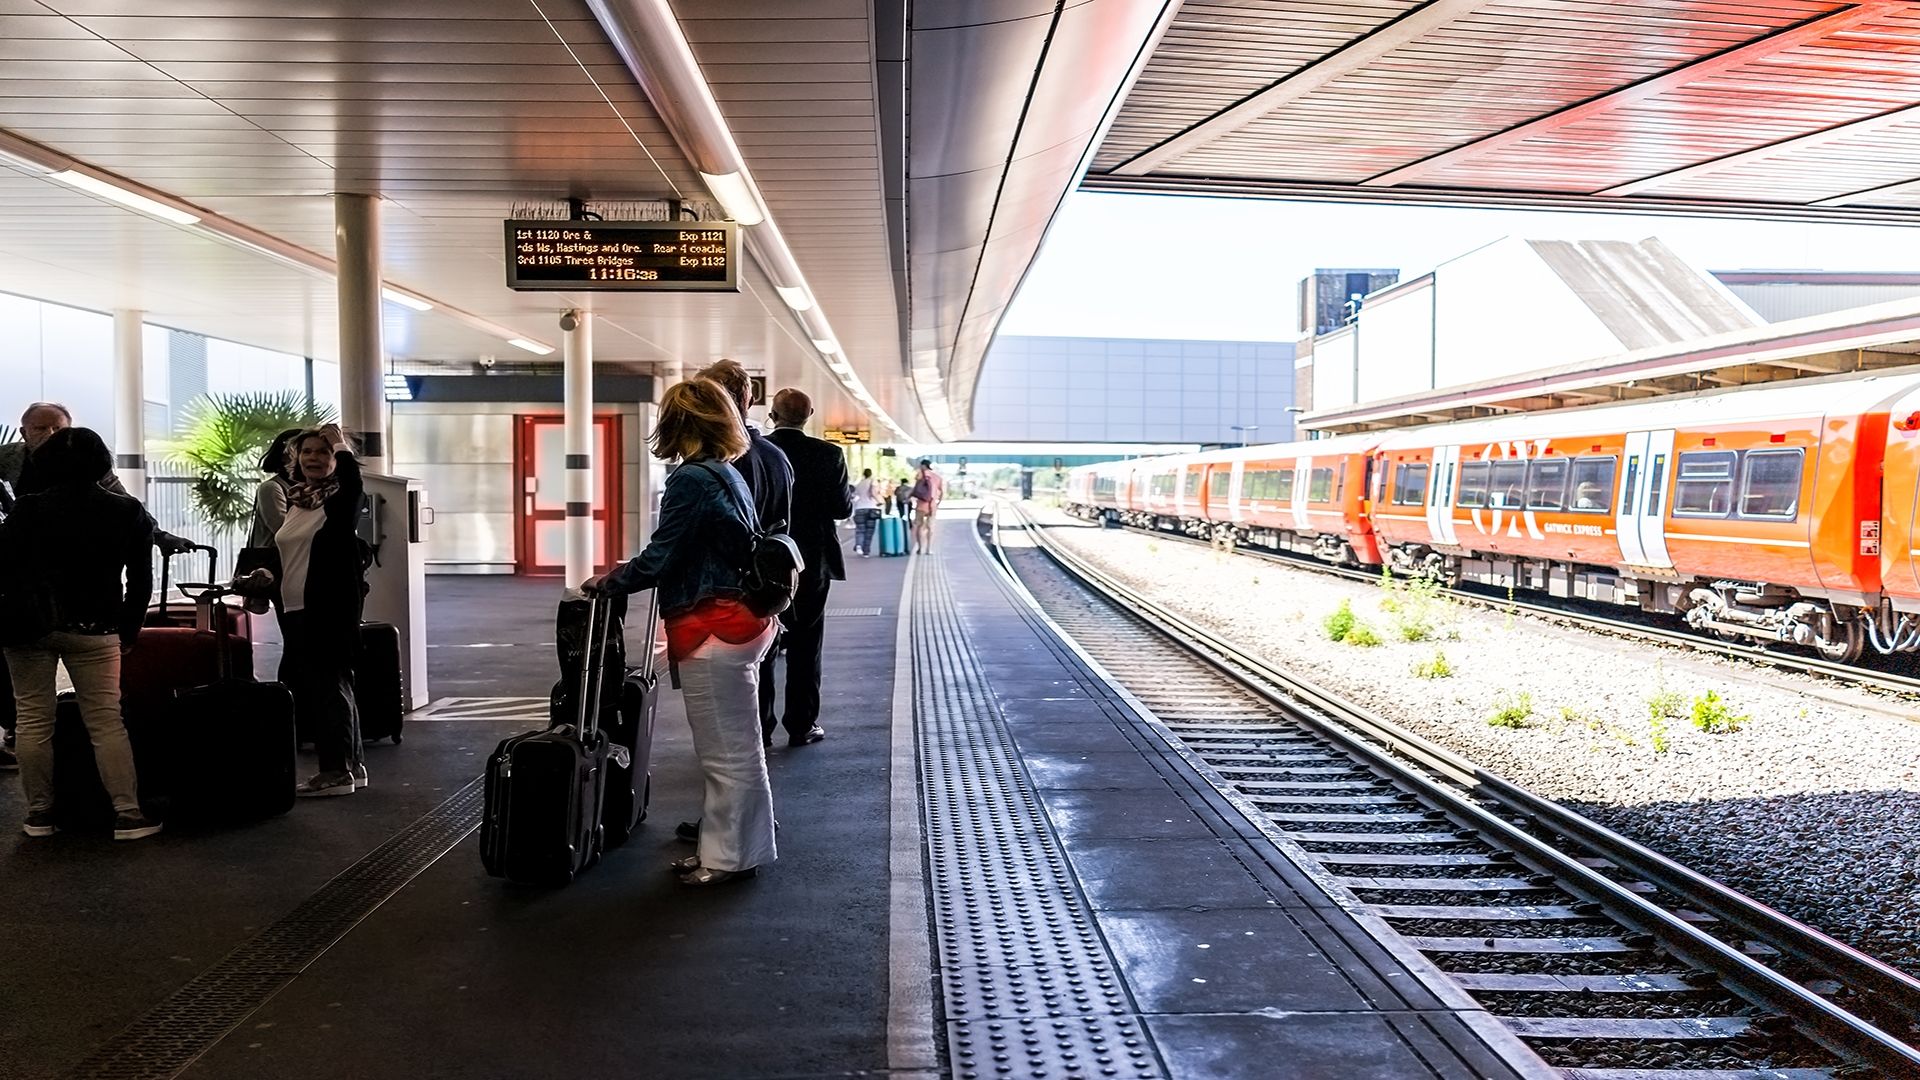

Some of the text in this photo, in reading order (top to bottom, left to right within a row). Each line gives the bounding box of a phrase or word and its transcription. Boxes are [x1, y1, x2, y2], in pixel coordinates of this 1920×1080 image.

[516, 229, 533, 240] 1st
[536, 229, 560, 240] 1120
[562, 230, 581, 240] Ore
[679, 231, 699, 243] Exp
[701, 231, 724, 241] 1121
[556, 242, 599, 255] Hastings
[600, 243, 620, 253] and
[653, 243, 677, 253] Rear
[680, 243, 687, 254] 4
[517, 255, 726, 268] 3rd 1105 Three Bridges Exp 1132
[1543, 522, 1603, 537] GATWICK EXPRESS
